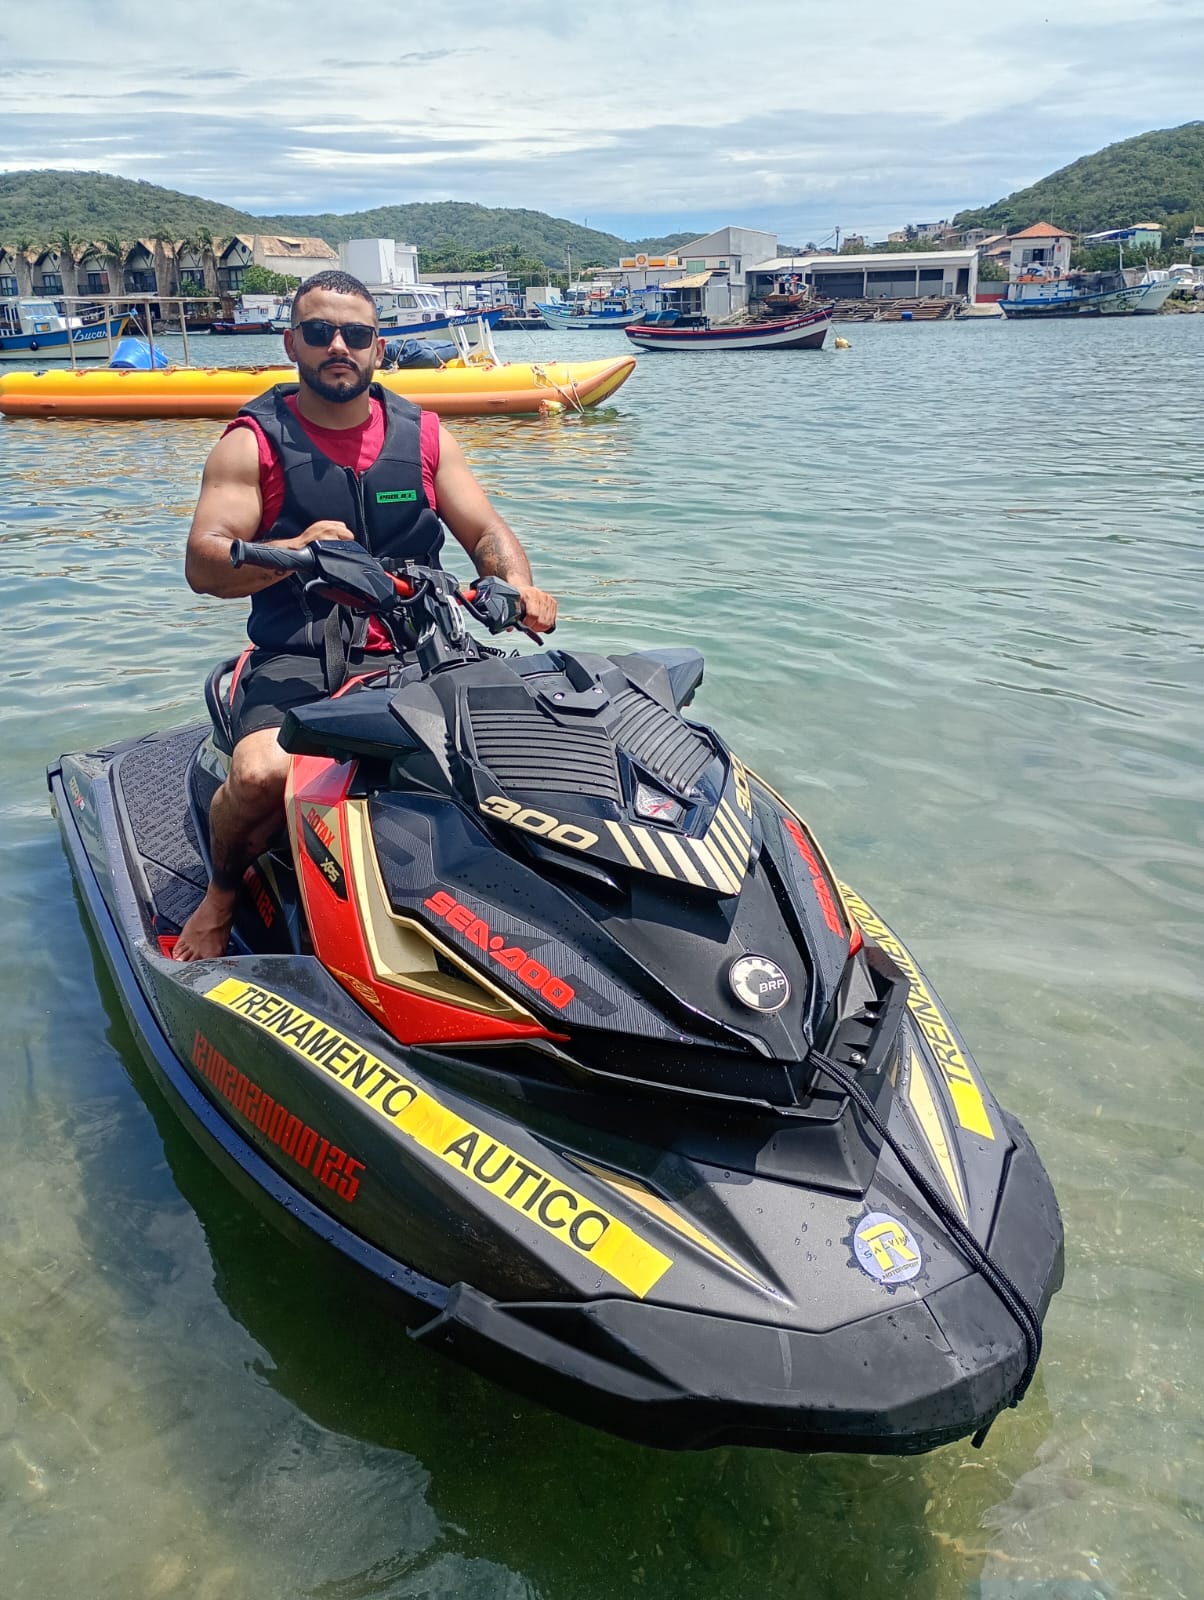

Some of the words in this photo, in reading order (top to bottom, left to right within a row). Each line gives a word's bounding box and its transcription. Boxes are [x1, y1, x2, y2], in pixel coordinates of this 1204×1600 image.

[306, 807, 336, 849] ROTAX
[480, 795, 599, 851] 300
[320, 857, 341, 882] XPS
[759, 979, 786, 993] BRP
[228, 986, 418, 1117] TREINAMENTO
